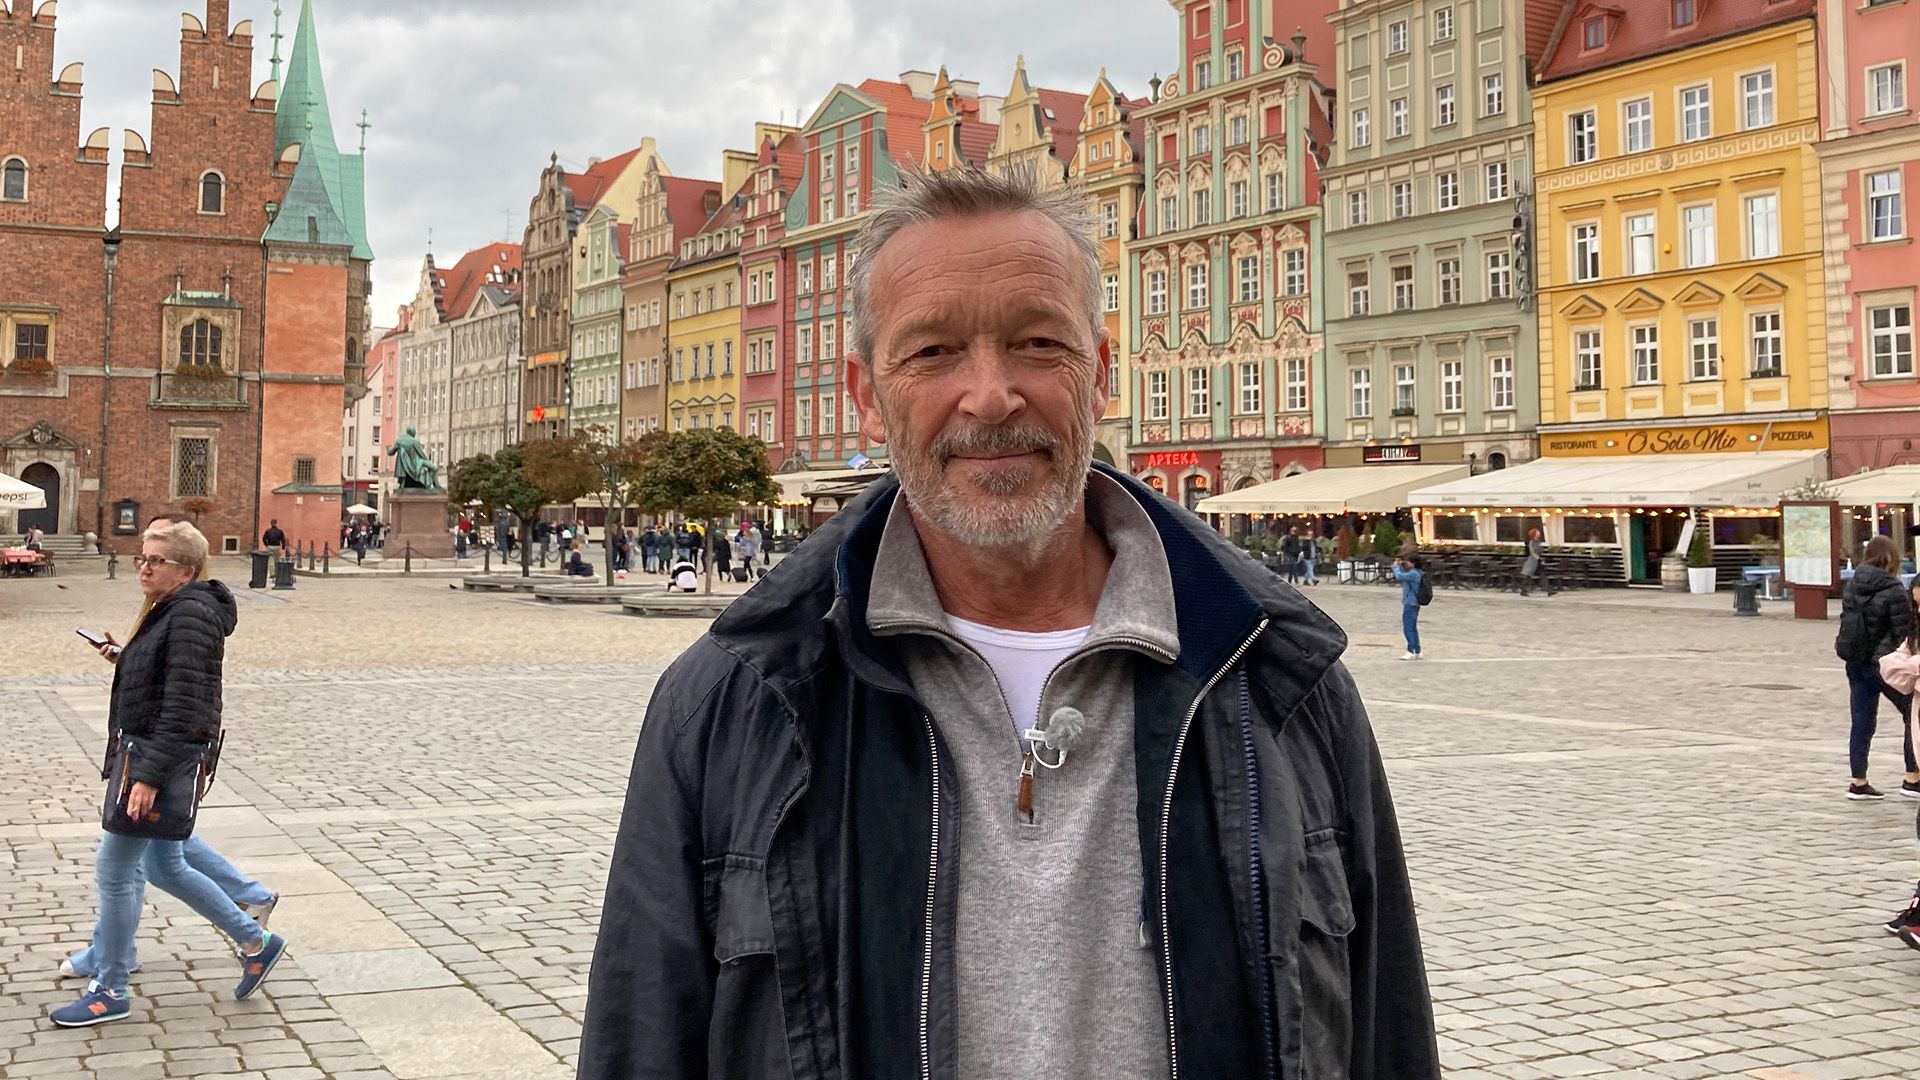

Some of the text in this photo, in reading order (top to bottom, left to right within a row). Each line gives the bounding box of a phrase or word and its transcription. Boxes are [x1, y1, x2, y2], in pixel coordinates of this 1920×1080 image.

[1550, 439, 1598, 450] RISTORANTE
[1650, 430, 1690, 454] Sole
[1693, 428, 1738, 451] Mio
[1771, 431, 1814, 441] PIZZERIA
[1148, 452, 1199, 466] APTEKA
